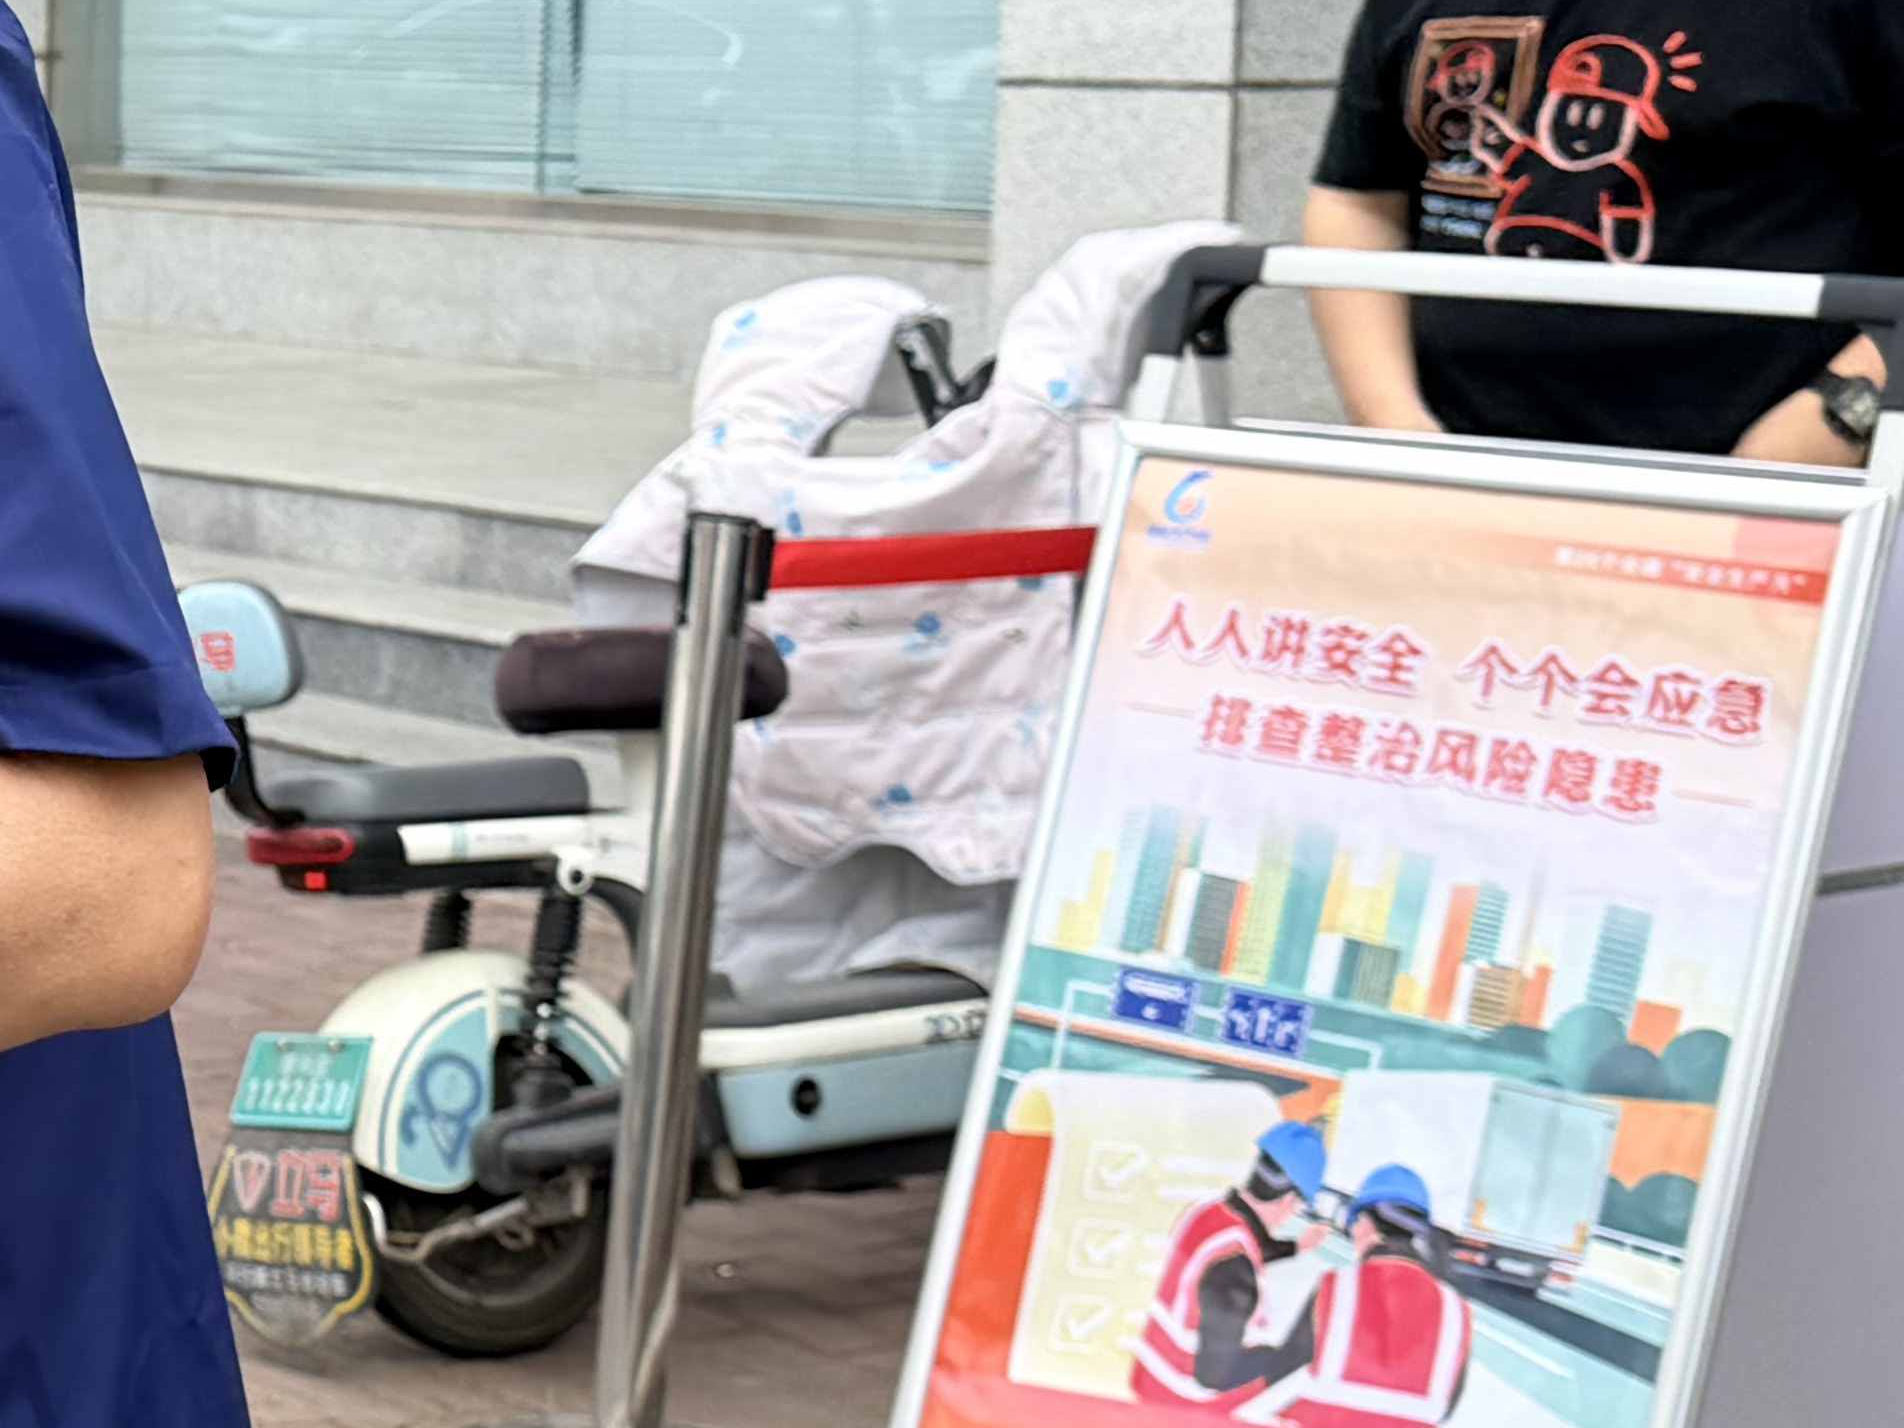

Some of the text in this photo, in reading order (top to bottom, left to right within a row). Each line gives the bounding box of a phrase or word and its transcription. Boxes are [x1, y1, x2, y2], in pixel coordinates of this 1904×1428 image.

[1146, 598, 1764, 738] 人人讲安全 个个会应急
[1202, 693, 1664, 815] 排查整治风险隐患
